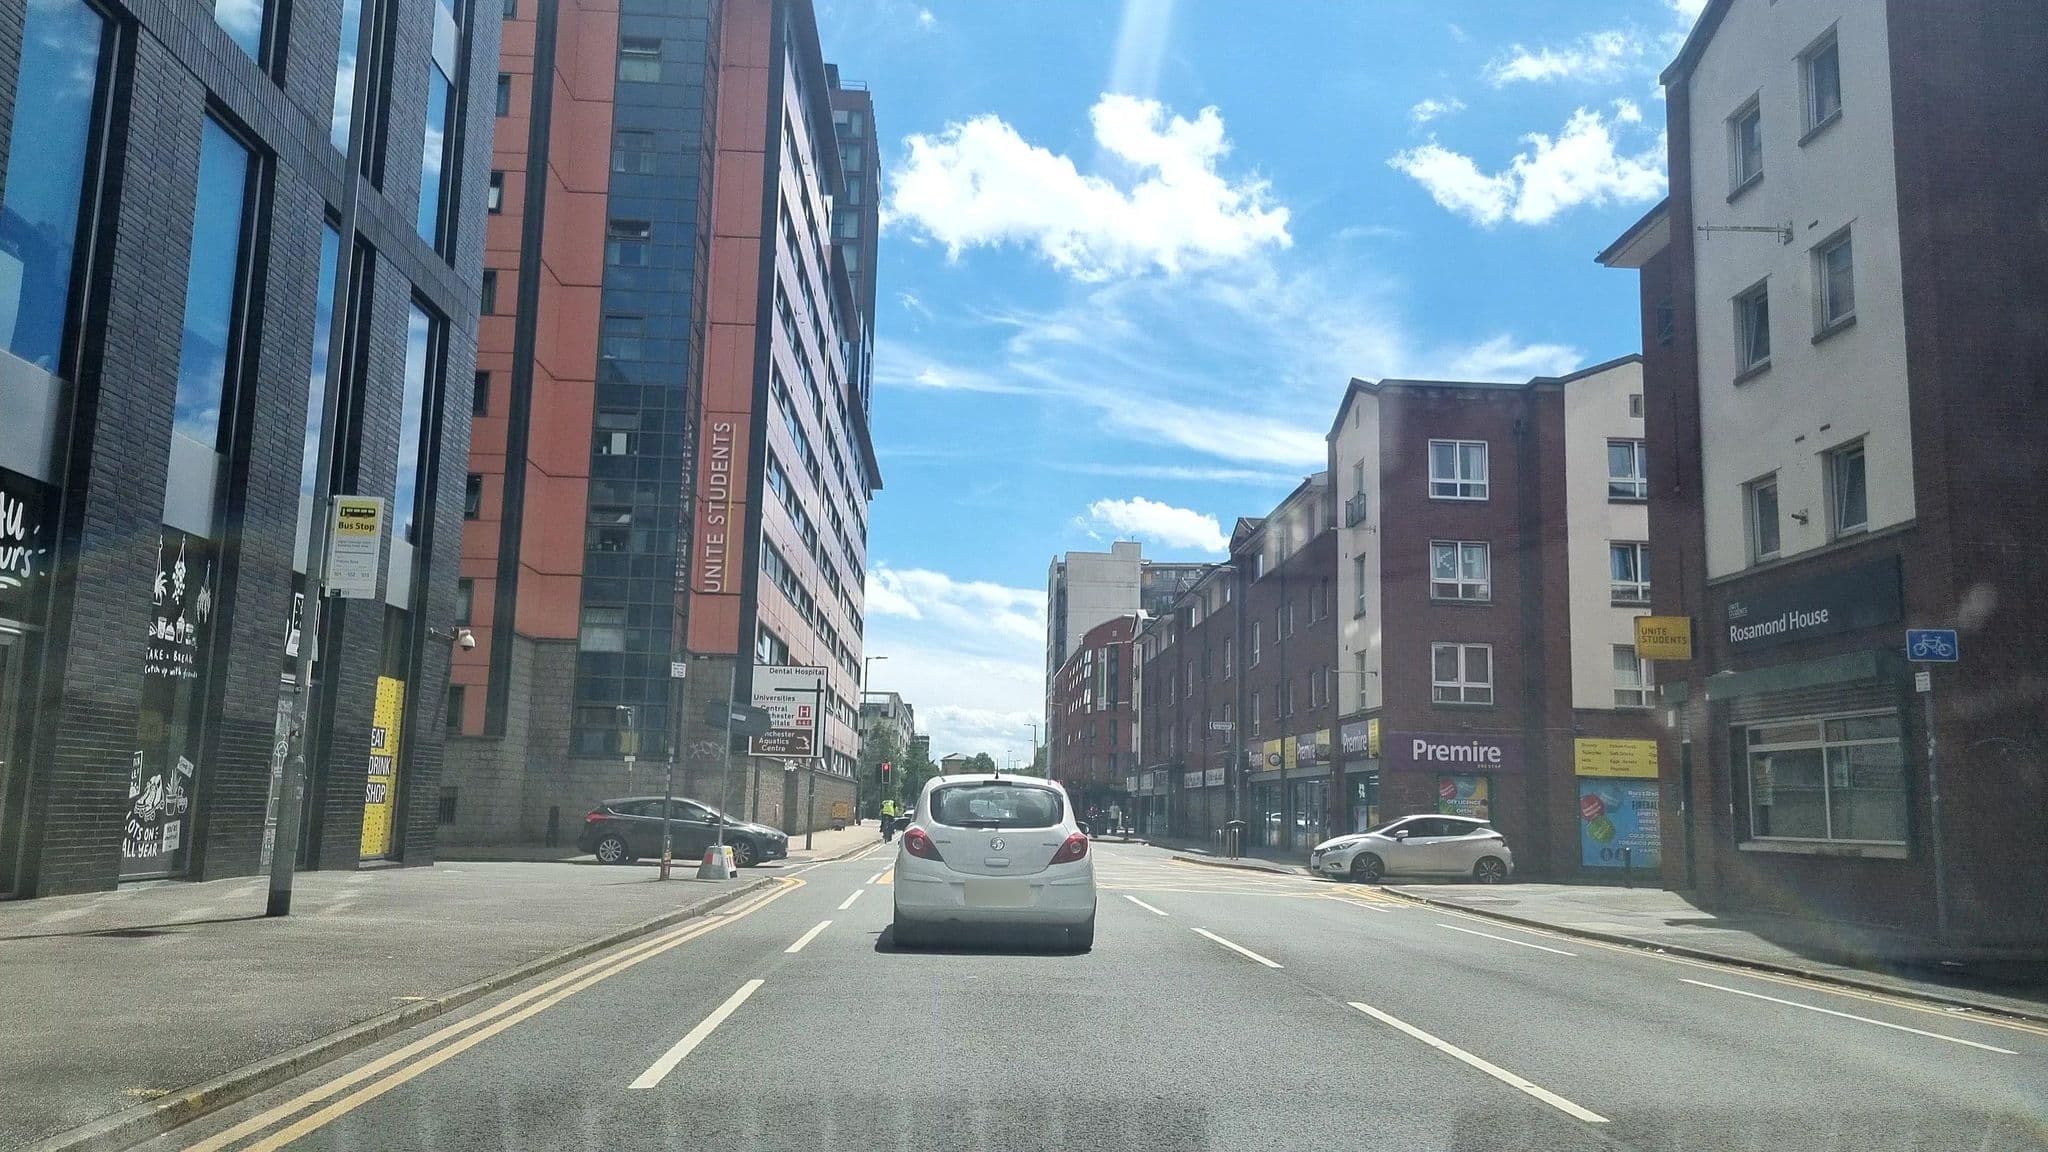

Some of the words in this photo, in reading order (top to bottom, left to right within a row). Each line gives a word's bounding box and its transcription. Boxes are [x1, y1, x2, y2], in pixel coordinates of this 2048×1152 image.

[707, 422, 731, 525] STUDENTS
[338, 522, 353, 530] Bus
[355, 522, 375, 532] Stop
[703, 533, 724, 593] UNITE
[1641, 627, 1667, 636] UNITE
[1730, 612, 1786, 643] Rosamond
[1789, 608, 1829, 630] House
[1641, 636, 1688, 645] STUDENTS
[769, 667, 793, 675] Dental
[795, 668, 825, 676] Hospital
[800, 707, 809, 717] H
[371, 728, 385, 747] EAT
[761, 744, 786, 752] Centre
[1412, 739, 1501, 762] Premire
[368, 756, 391, 775] DRINK
[365, 783, 386, 803] SHOP
[122, 838, 136, 858] ALL
[138, 842, 158, 858] YEAR
